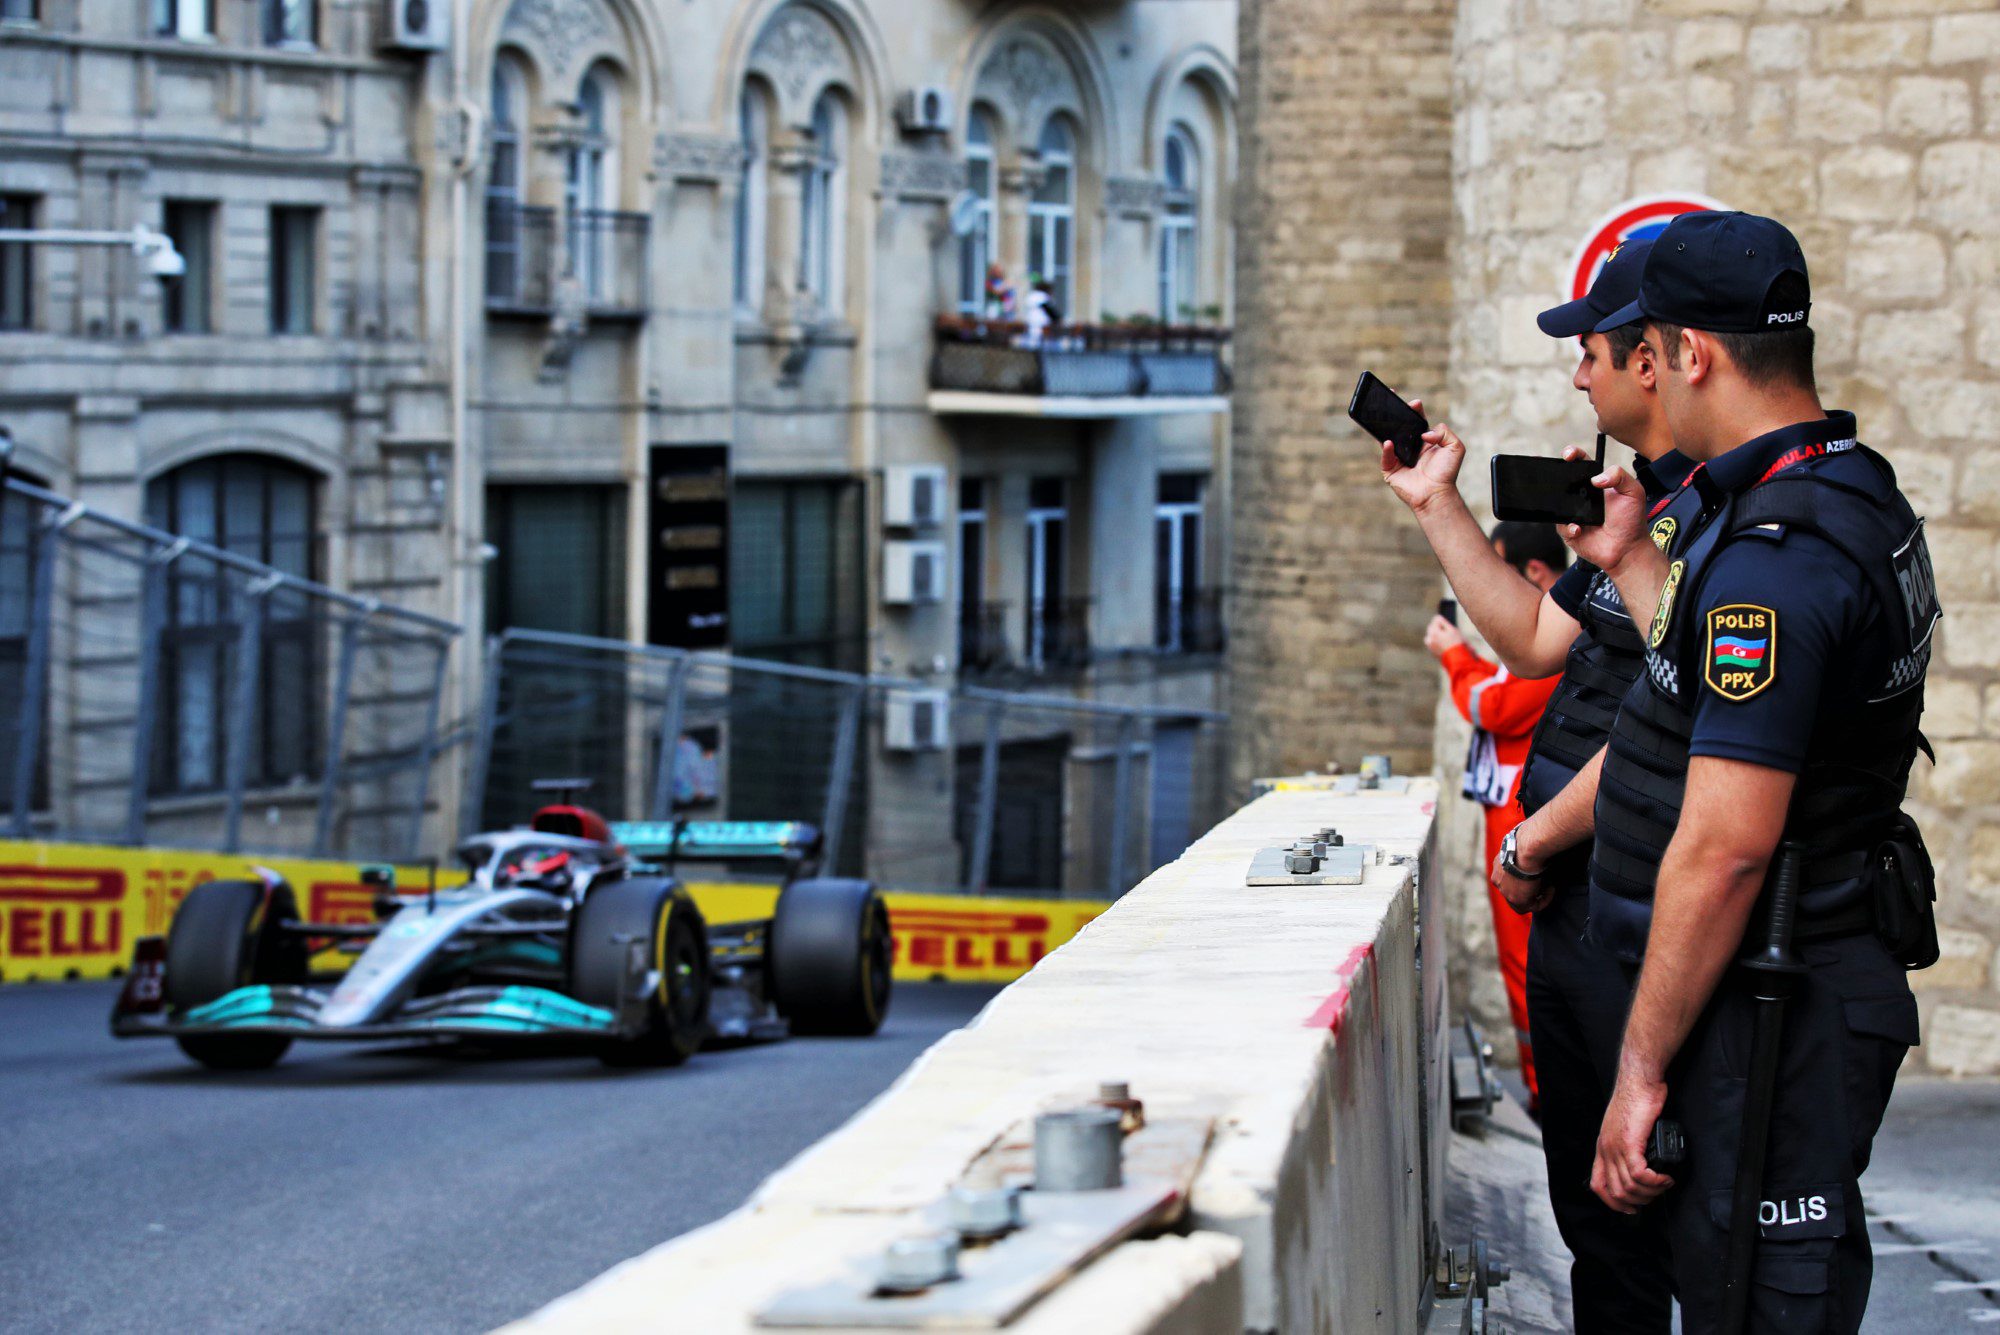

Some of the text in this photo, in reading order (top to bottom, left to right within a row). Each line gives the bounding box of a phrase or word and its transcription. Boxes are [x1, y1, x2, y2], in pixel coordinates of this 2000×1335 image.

[1760, 445, 1816, 483] RMULA
[1721, 672, 1756, 690] PPX
[0, 907, 123, 957] ELLI
